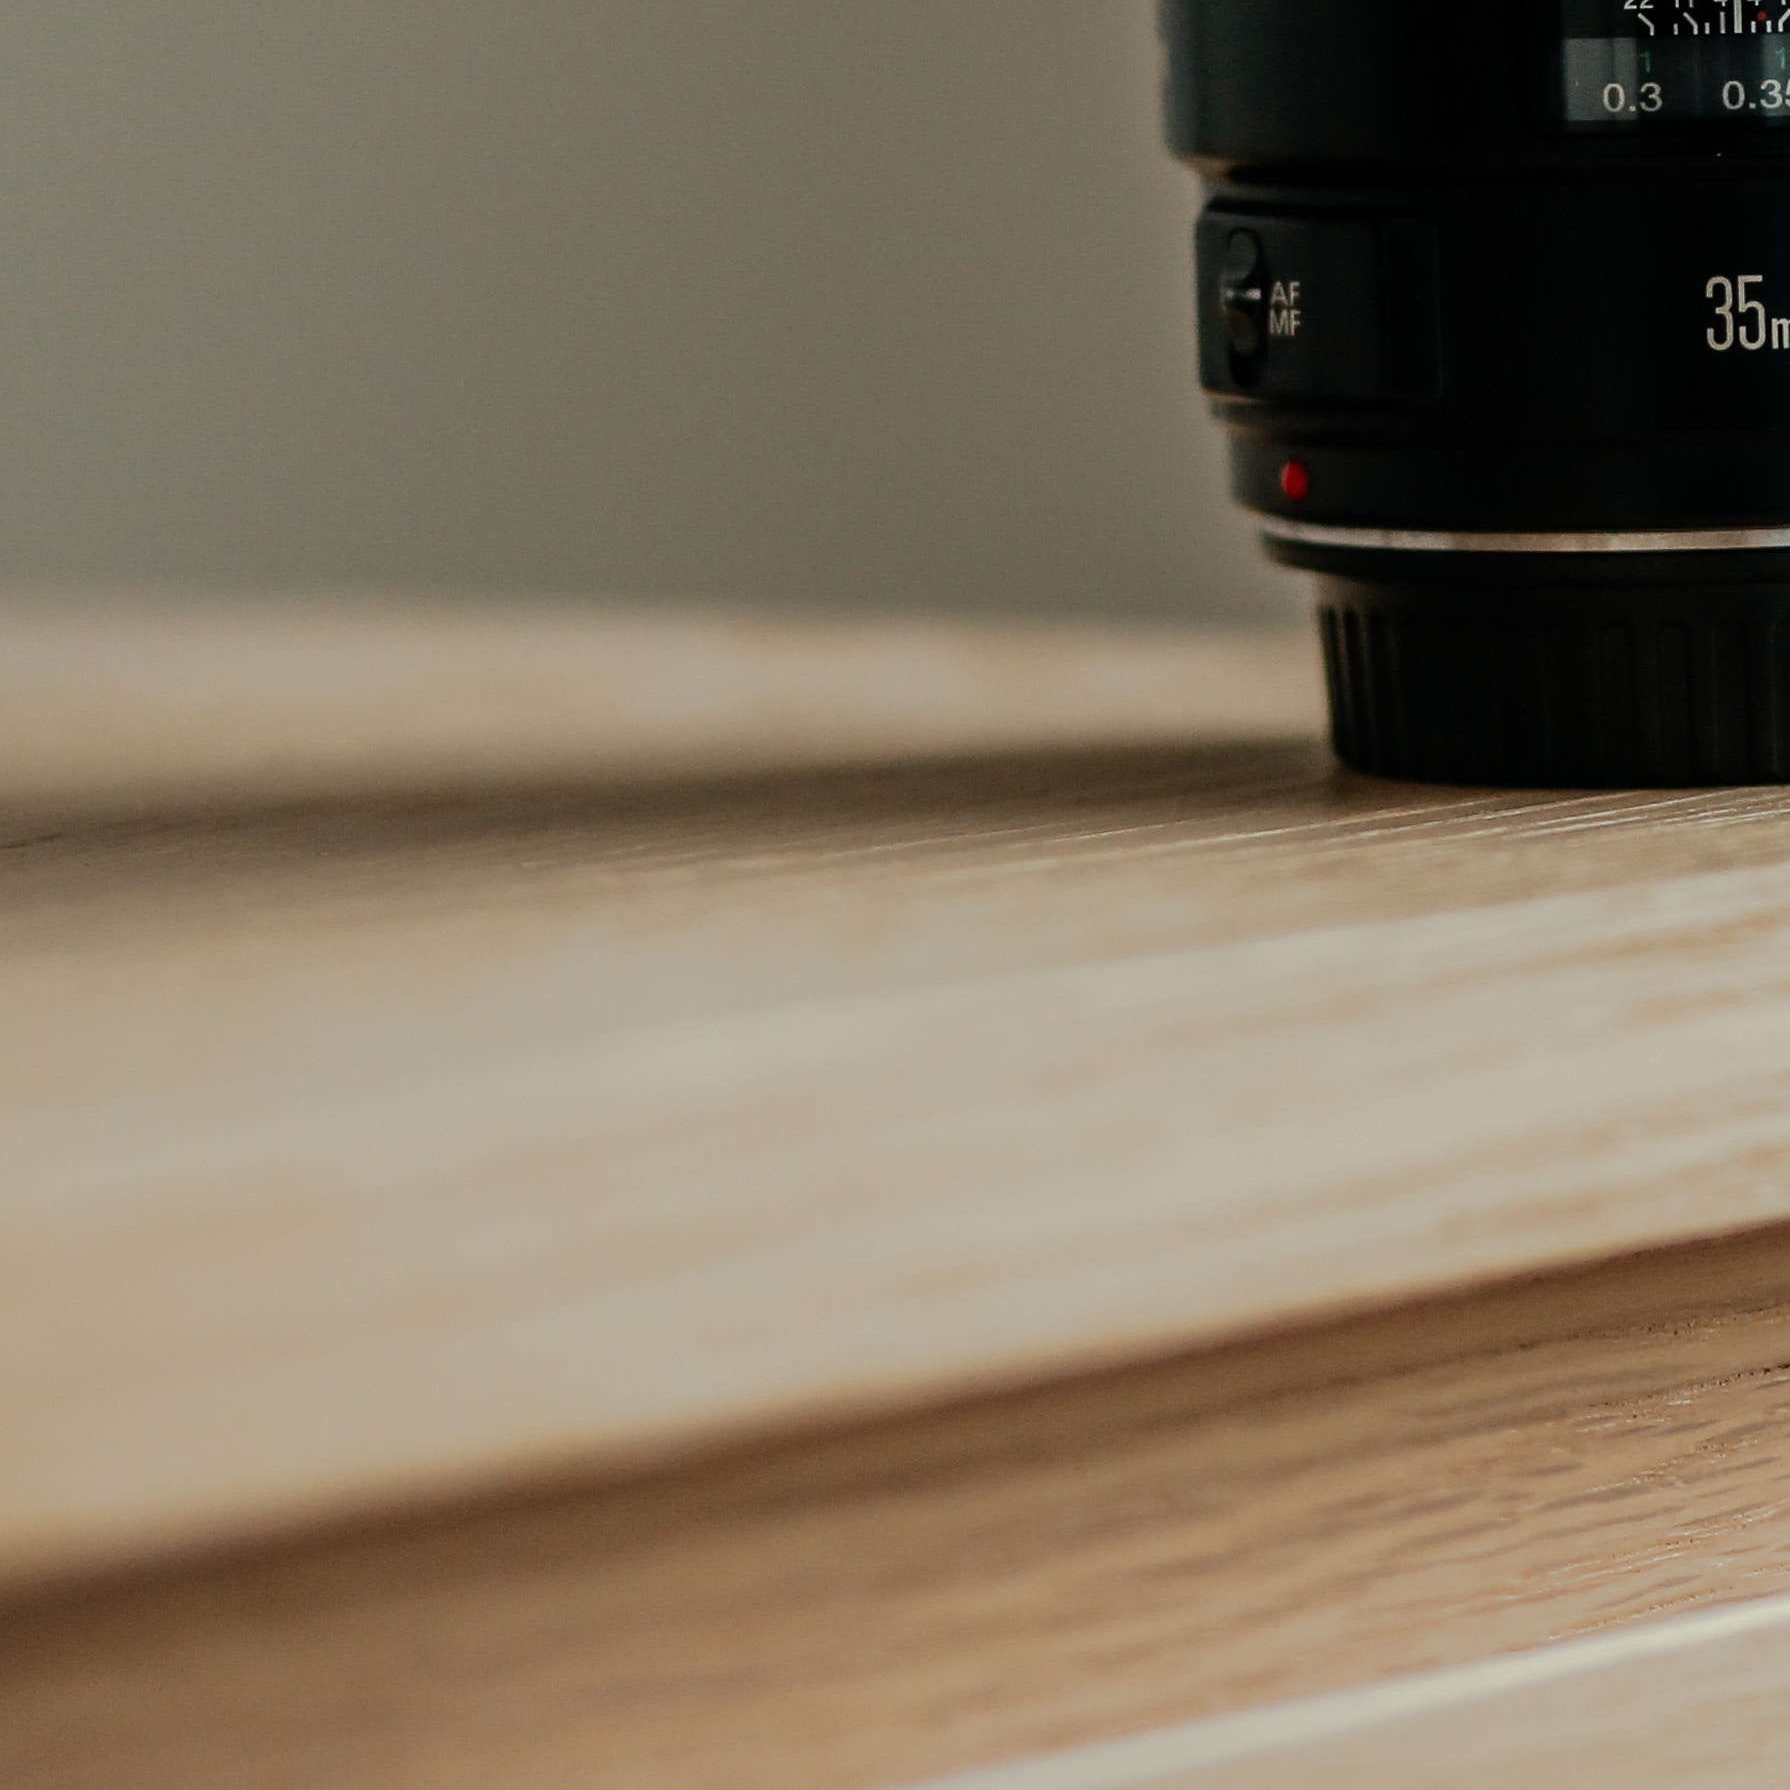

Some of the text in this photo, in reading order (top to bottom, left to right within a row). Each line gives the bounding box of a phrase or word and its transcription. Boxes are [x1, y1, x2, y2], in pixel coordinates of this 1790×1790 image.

[1639, 50, 1652, 72] 1
[1603, 82, 1663, 112] 0.3
[1269, 280, 1302, 307] AF
[1269, 309, 1302, 337] MF
